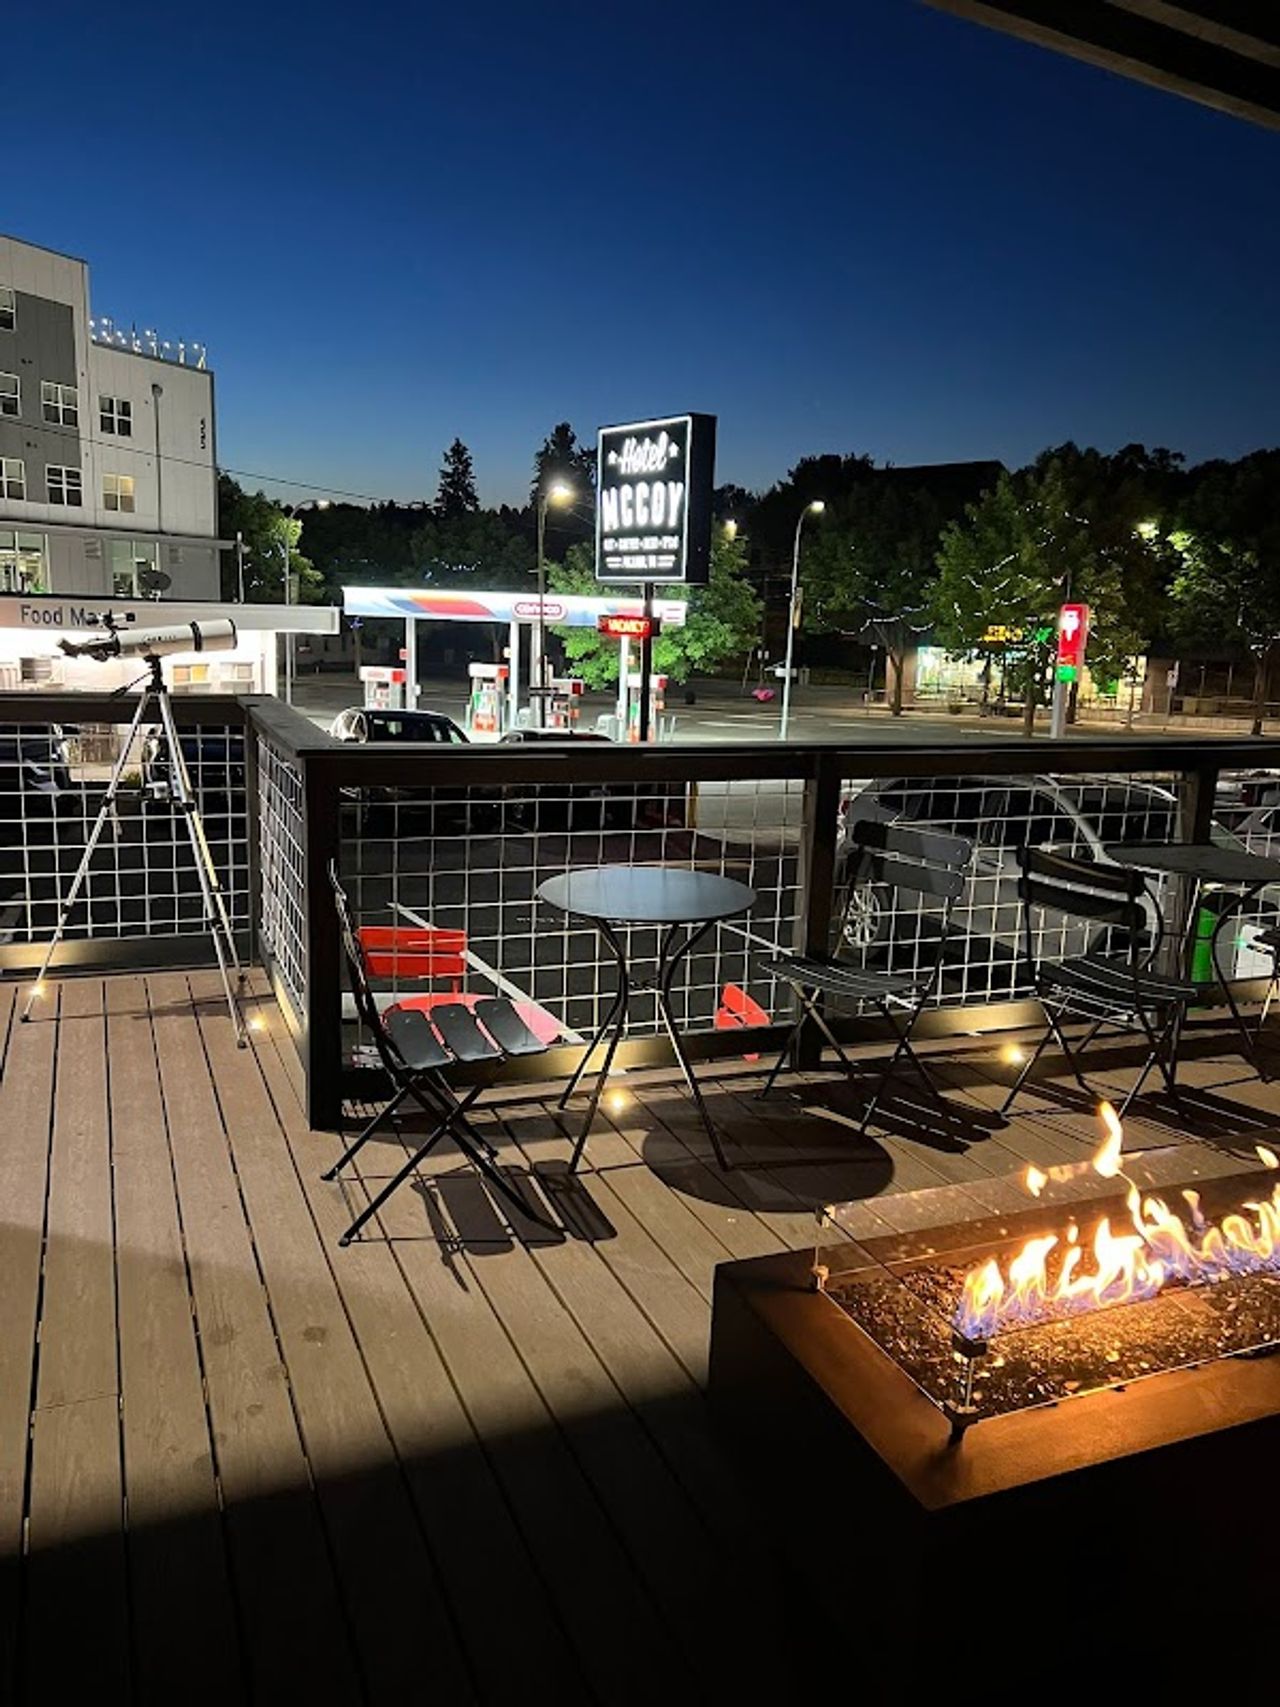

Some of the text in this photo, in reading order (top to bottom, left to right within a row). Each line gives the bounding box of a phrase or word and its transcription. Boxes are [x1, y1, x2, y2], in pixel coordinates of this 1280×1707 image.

[617, 431, 668, 475] Hotel
[602, 480, 684, 532] MCCOY
[21, 604, 63, 626] Food
